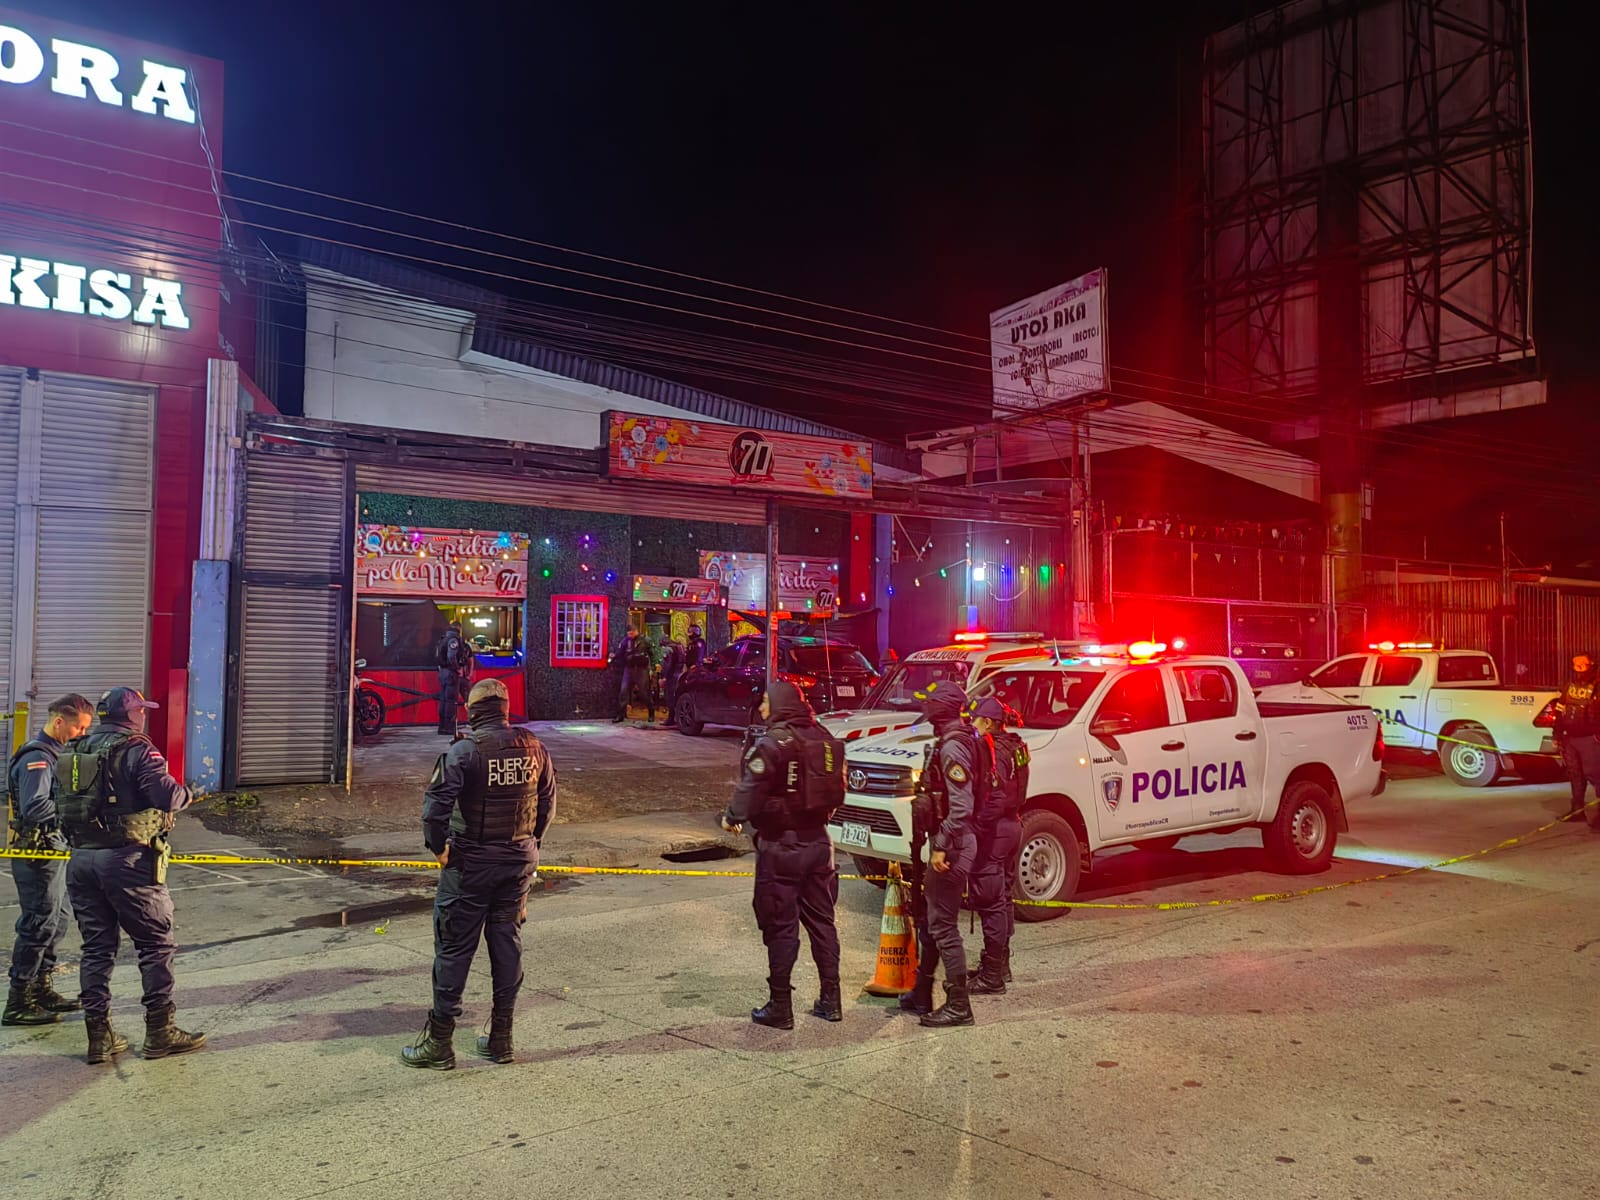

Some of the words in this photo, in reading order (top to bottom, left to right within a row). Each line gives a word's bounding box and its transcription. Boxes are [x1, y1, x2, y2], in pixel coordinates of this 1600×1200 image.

[740, 439, 773, 475] 70
[502, 573, 521, 592] 70
[673, 582, 688, 597] 70
[820, 592, 833, 607] 70
[1346, 715, 1368, 726] 4075
[488, 757, 539, 774] FUERZA
[488, 769, 538, 787] PUBLICA
[1132, 760, 1247, 803] POLICIA
